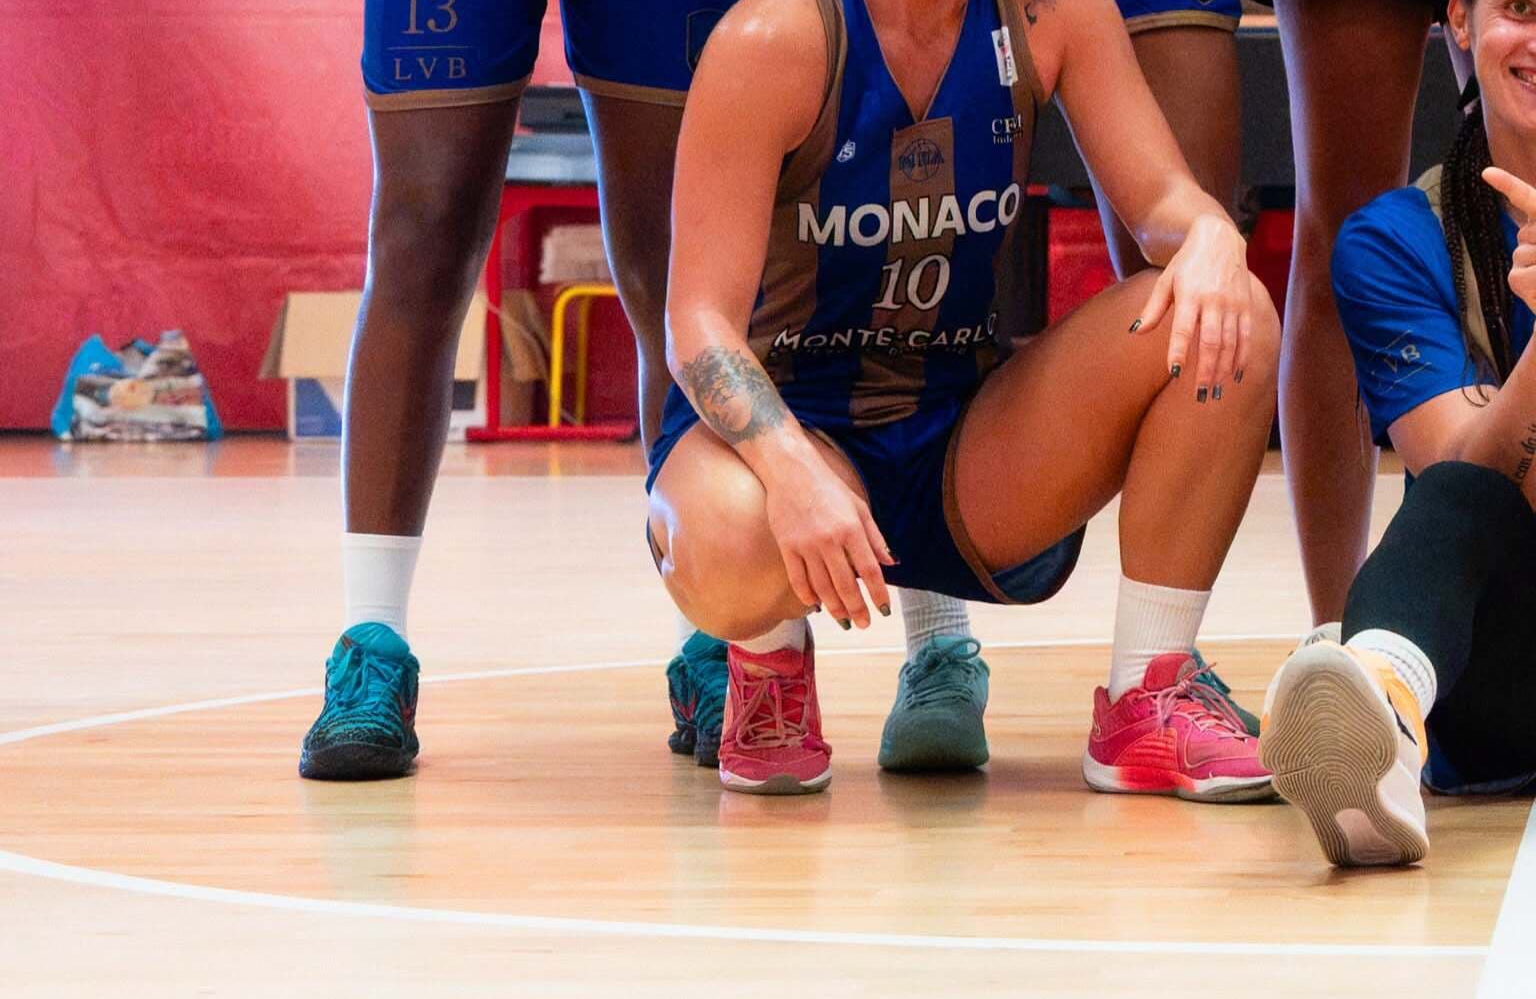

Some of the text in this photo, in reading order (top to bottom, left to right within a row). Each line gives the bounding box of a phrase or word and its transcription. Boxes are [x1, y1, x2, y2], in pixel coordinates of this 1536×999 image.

[395, 56, 467, 80] LVB
[798, 183, 1020, 247] MONACO
[872, 254, 950, 312] 10
